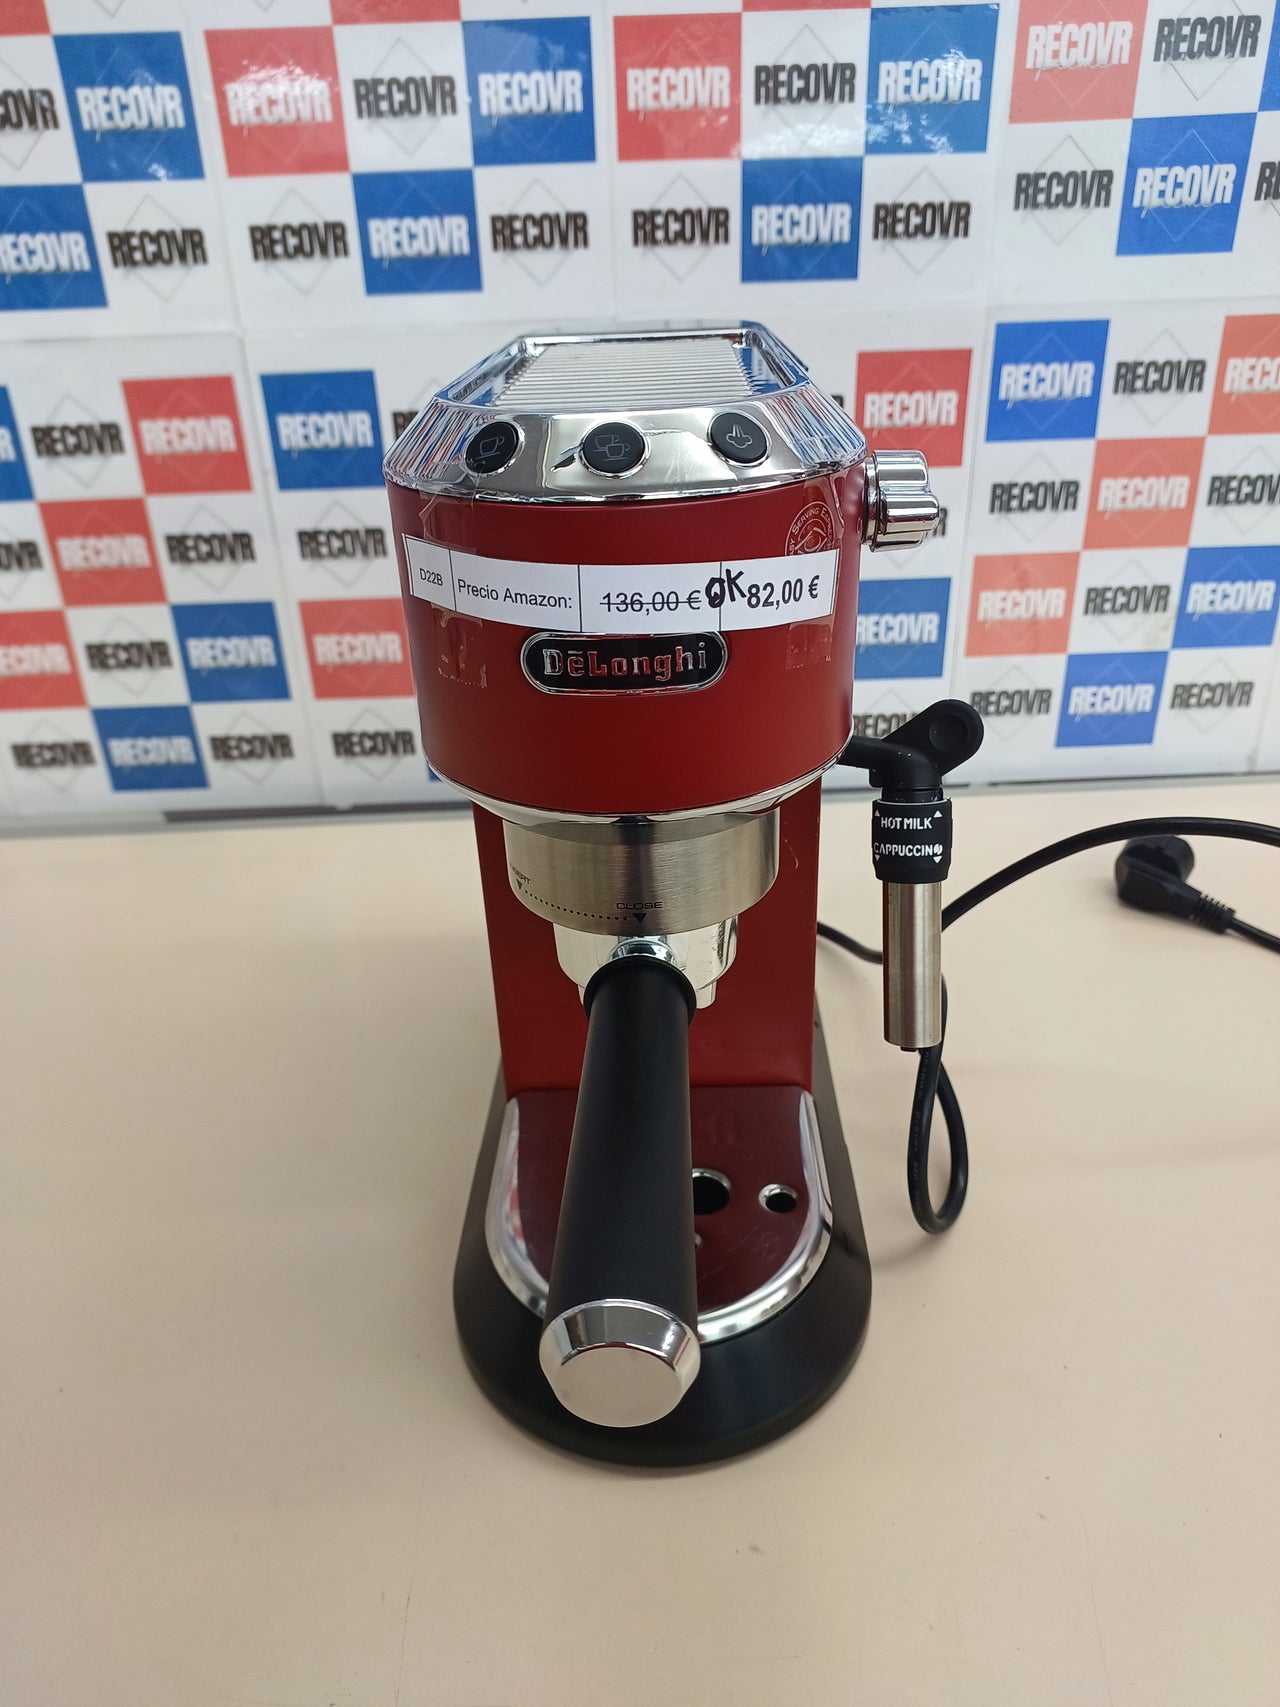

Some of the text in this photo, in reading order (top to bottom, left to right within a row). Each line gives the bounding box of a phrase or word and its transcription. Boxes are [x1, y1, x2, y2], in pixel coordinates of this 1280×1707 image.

[1026, 21, 1133, 70] RECOVR
[1154, 15, 1262, 62] RECOVR
[354, 75, 458, 119] RECOVR
[477, 70, 584, 116] RECOVR
[626, 67, 730, 111] RECOVR
[754, 62, 857, 105] RECOVR
[878, 59, 982, 103] RECOVR
[0, 88, 59, 130] OVR
[76, 85, 185, 131] RECOVR
[224, 82, 333, 126] RECOVR
[1014, 169, 1115, 211] RECOVR
[1132, 164, 1237, 209] RECOVR
[367, 214, 470, 258] RECOVR
[490, 211, 589, 251] RECOVR
[633, 207, 730, 247] RECOVR
[751, 203, 852, 246] RECOVR
[873, 201, 971, 241] RECOVR
[107, 228, 208, 268] RECOVR
[249, 222, 348, 261] RECOVR
[999, 361, 1095, 401] RECOVR
[1113, 359, 1206, 396] RECOVR
[1223, 356, 1280, 393] RECO
[863, 391, 959, 429] RECOVR
[31, 423, 125, 458] RECOVR
[138, 415, 238, 455] RECOVR
[276, 411, 374, 450] RECOVR
[989, 480, 1080, 514] RECOVR
[1097, 475, 1190, 512] RECOVR
[1206, 474, 1280, 507] RECOV
[56, 534, 150, 570] RECOVR
[165, 532, 256, 564] RECOVR
[297, 528, 388, 560] RECOVR
[419, 568, 444, 586] D22B
[747, 575, 820, 610] 82,00 €
[457, 579, 701, 615] Precio Amazon: 136,00 €
[977, 588, 1066, 621] RECOVR
[1084, 584, 1171, 617] RECOVR
[1185, 580, 1277, 614] RECOVR
[857, 612, 940, 646] RECOVR
[0, 643, 72, 676] ECOVR
[85, 641, 175, 670] RECOVR
[187, 636, 277, 669] RECOVR
[312, 633, 403, 666] RECOVR
[971, 689, 1052, 717] RECOVR
[1068, 684, 1155, 716] RECOVR
[1170, 681, 1254, 710] RECOVR
[11, 741, 97, 769] RECOVR
[107, 736, 197, 767] RECOVR
[210, 733, 294, 762] RECOVR
[332, 730, 416, 758] RECOVR
[881, 817, 932, 829] HOT MILK
[616, 901, 663, 910] CLOSE
